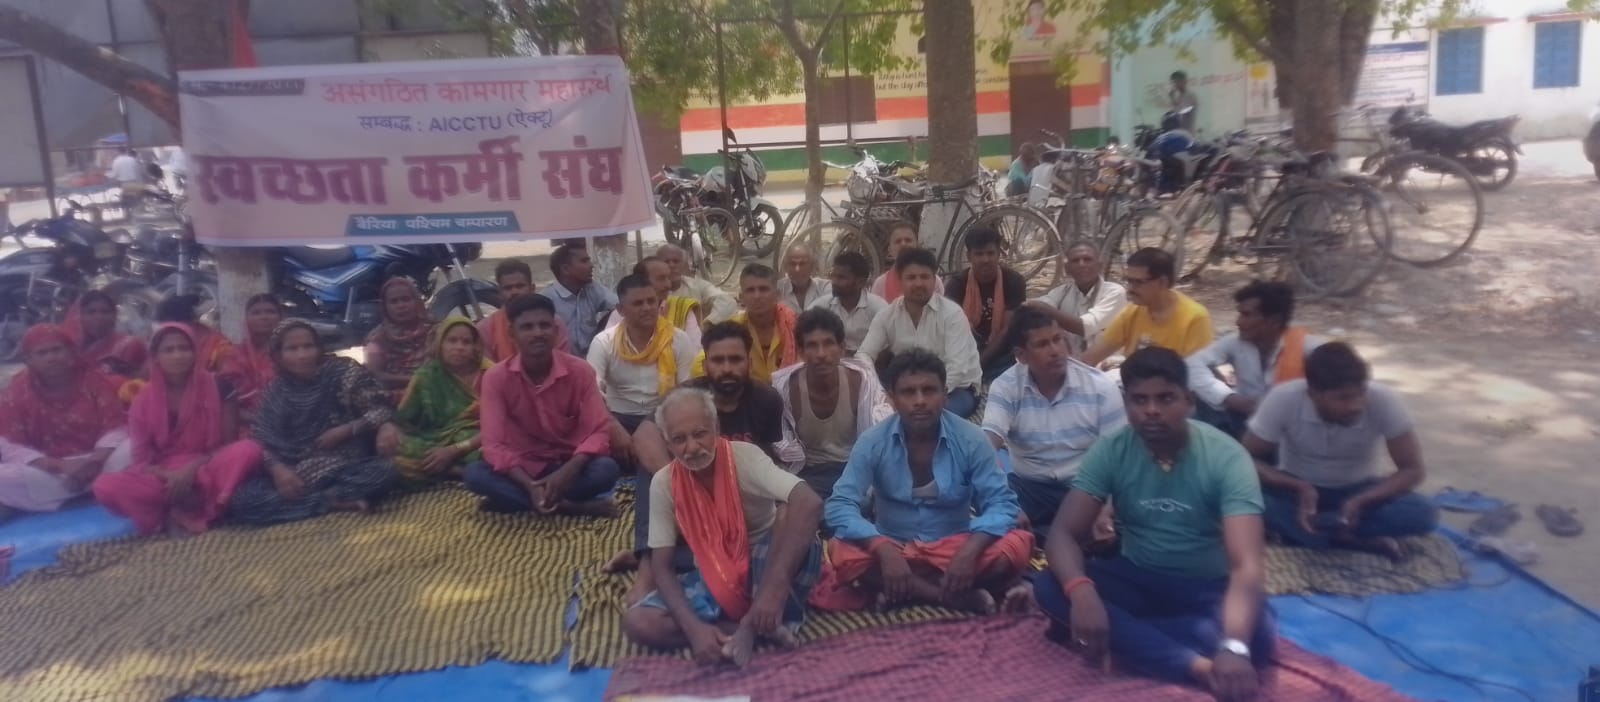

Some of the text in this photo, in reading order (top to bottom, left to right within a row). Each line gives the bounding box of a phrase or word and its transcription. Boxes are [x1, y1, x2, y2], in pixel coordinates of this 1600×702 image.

[321, 78, 428, 104] असंगठित
[434, 80, 529, 103] कामगार
[429, 113, 502, 133] AICCTU
[193, 135, 624, 205] स्वच्छता कर्मी संघ
[405, 215, 452, 229] पश्चिम
[454, 215, 508, 229] चम्पारण
